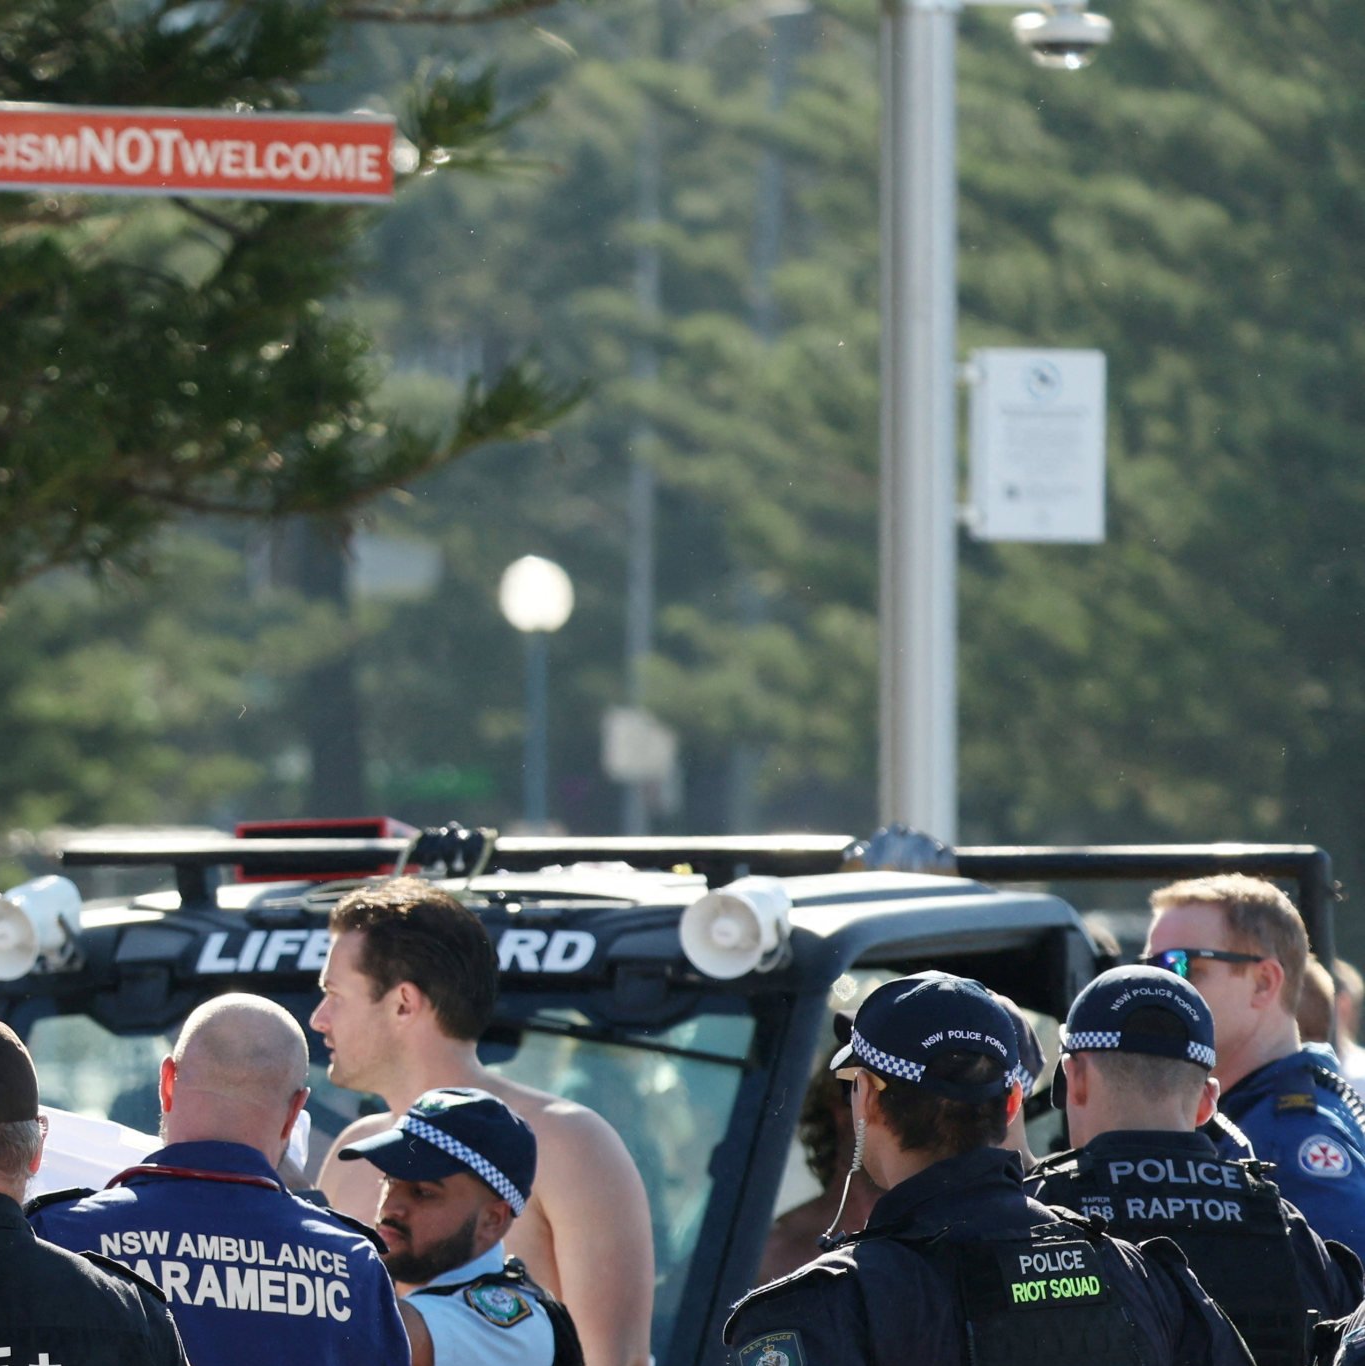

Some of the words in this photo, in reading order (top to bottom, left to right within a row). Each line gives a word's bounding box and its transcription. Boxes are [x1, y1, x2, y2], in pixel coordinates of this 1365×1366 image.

[1111, 989, 1131, 1011] NSW
[1132, 987, 1173, 998] POLICE
[1174, 995, 1200, 1022] FORCE
[921, 1032, 943, 1049] NSW
[948, 1030, 981, 1040] POLICE
[985, 1035, 1008, 1057] FORCE
[1108, 1158, 1242, 1189] POLICE
[1126, 1197, 1243, 1222] RAPTOR
[100, 1230, 170, 1256] NSW
[176, 1232, 350, 1279] AMBULANCE
[1019, 1250, 1085, 1274] POLICE
[117, 1259, 352, 1323] ARAMEDIC
[1012, 1280, 1047, 1303] RIOT
[1051, 1275, 1100, 1299] SQUAD
